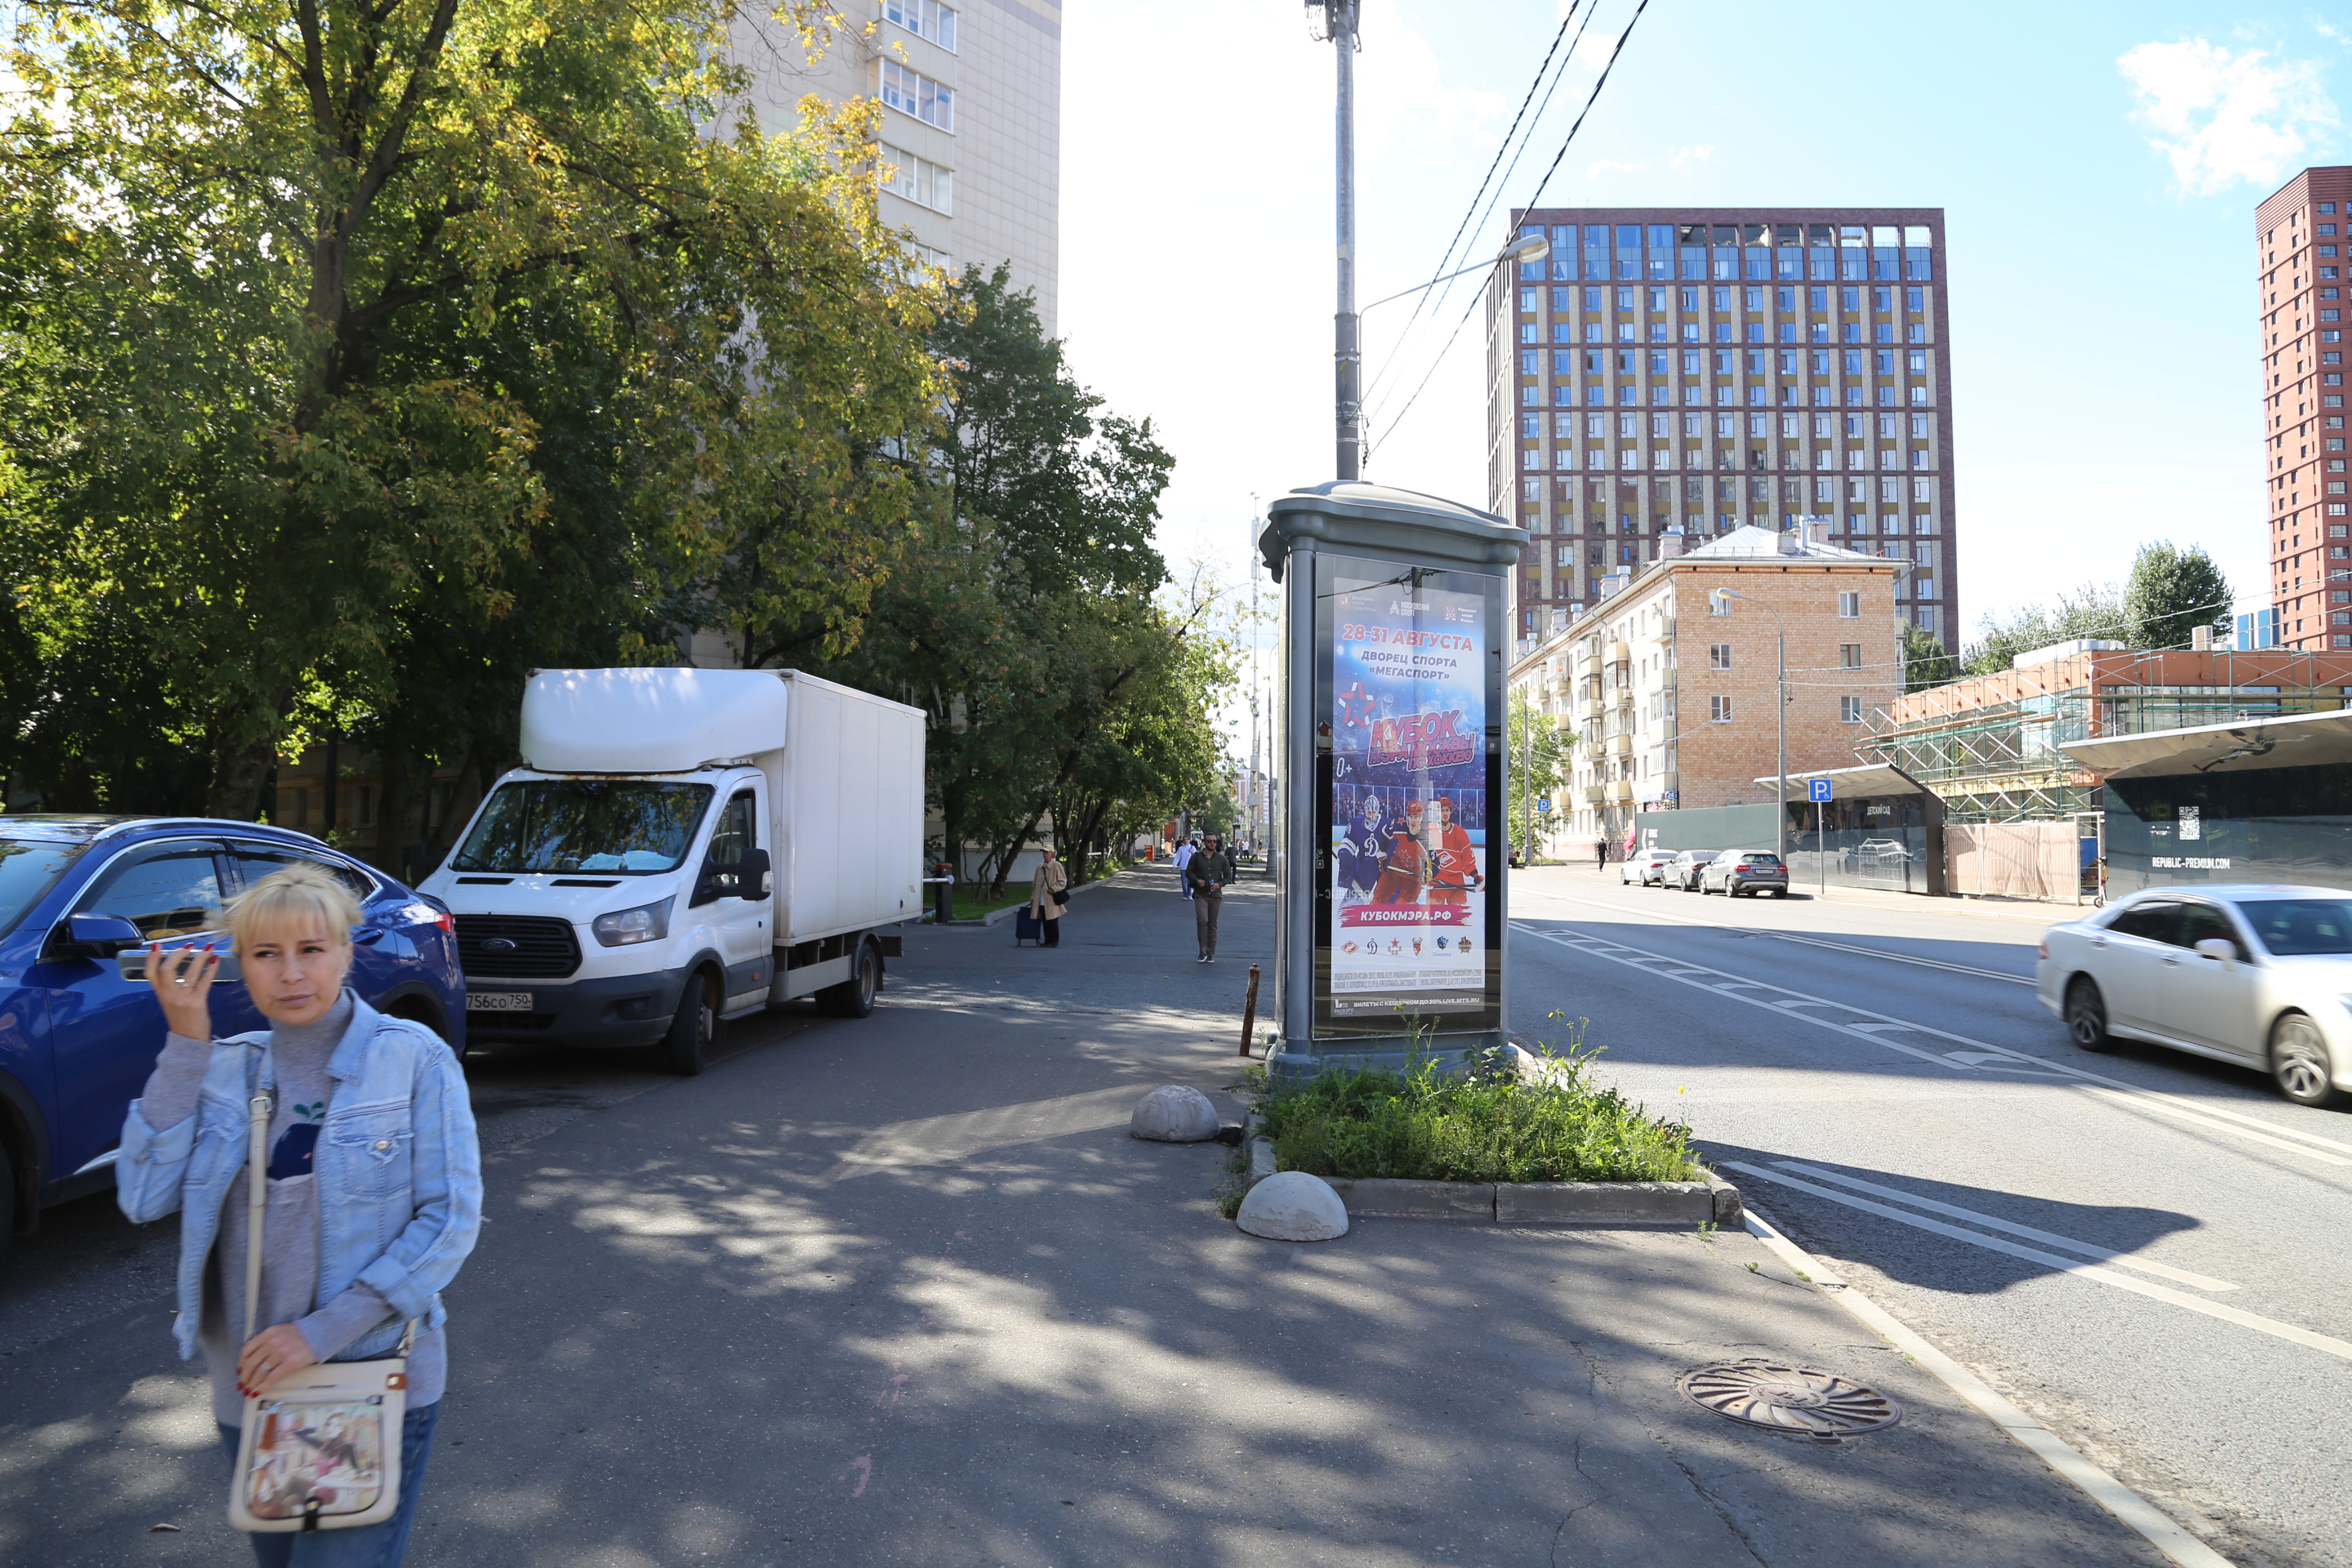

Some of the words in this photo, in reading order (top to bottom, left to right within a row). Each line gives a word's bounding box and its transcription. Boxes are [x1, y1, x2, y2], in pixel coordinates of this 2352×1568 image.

[1401, 601, 1430, 611] МОСКОВСКИЙ
[1401, 609, 1415, 617] СПОРТ
[1342, 624, 1388, 643] 28-31
[1392, 629, 1473, 651] АВГУСТА
[1361, 651, 1408, 665] ДВОРЕЦ
[1412, 655, 1457, 667] СПОРТА
[1369, 666, 1450, 680] «МЕГАСПОРТ»
[1371, 709, 1460, 748] КУБОК
[1369, 744, 1408, 765] МЭРА
[1409, 733, 1475, 758] МОСКВЫ
[1407, 756, 1427, 770] ПО
[1427, 749, 1473, 767] ХОККЕЮ
[1336, 757, 1353, 778] 0+
[1867, 804, 1883, 816] ДЕТСКИЙ
[2152, 857, 2230, 869] REPUBLIC-PREMIUM.COM
[1360, 910, 1452, 921] КУБОКМЭРА.РФ
[509, 995, 528, 1004] 750
